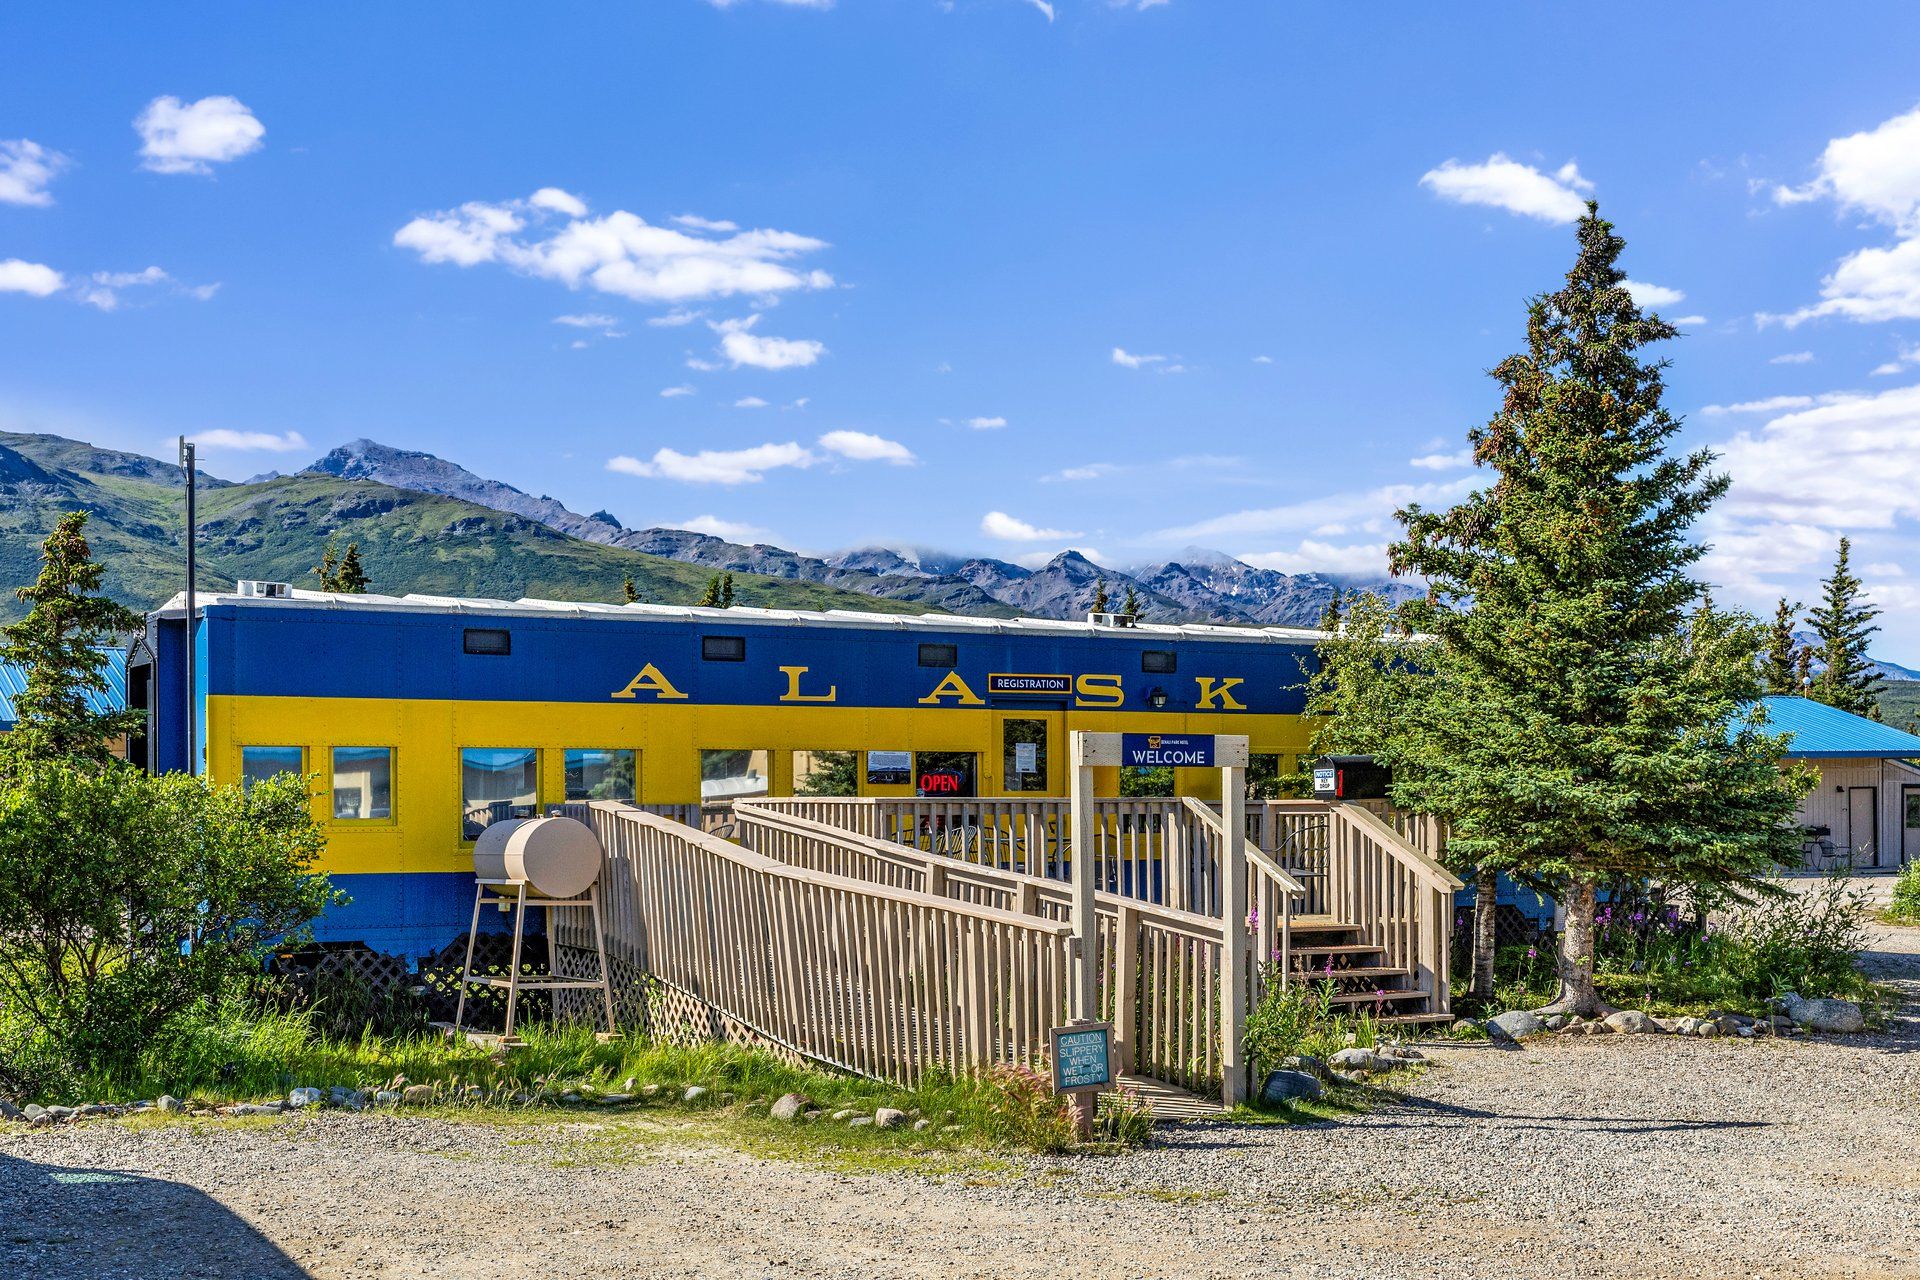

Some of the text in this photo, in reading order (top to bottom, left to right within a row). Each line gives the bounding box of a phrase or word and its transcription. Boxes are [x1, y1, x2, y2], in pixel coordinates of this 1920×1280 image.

[610, 662, 1346, 711] ALASK
[997, 678, 1064, 689] REGISTRATION
[1132, 750, 1205, 764] WELCOME
[1315, 770, 1333, 778] NOTICE
[920, 774, 959, 792] OPEN
[1060, 1033, 1102, 1046] CAUTION
[1060, 1044, 1104, 1058] SLIPPERY
[1069, 1055, 1097, 1066] WHEN
[1063, 1063, 1104, 1076] WET OR
[1065, 1073, 1103, 1085] FROSTY
